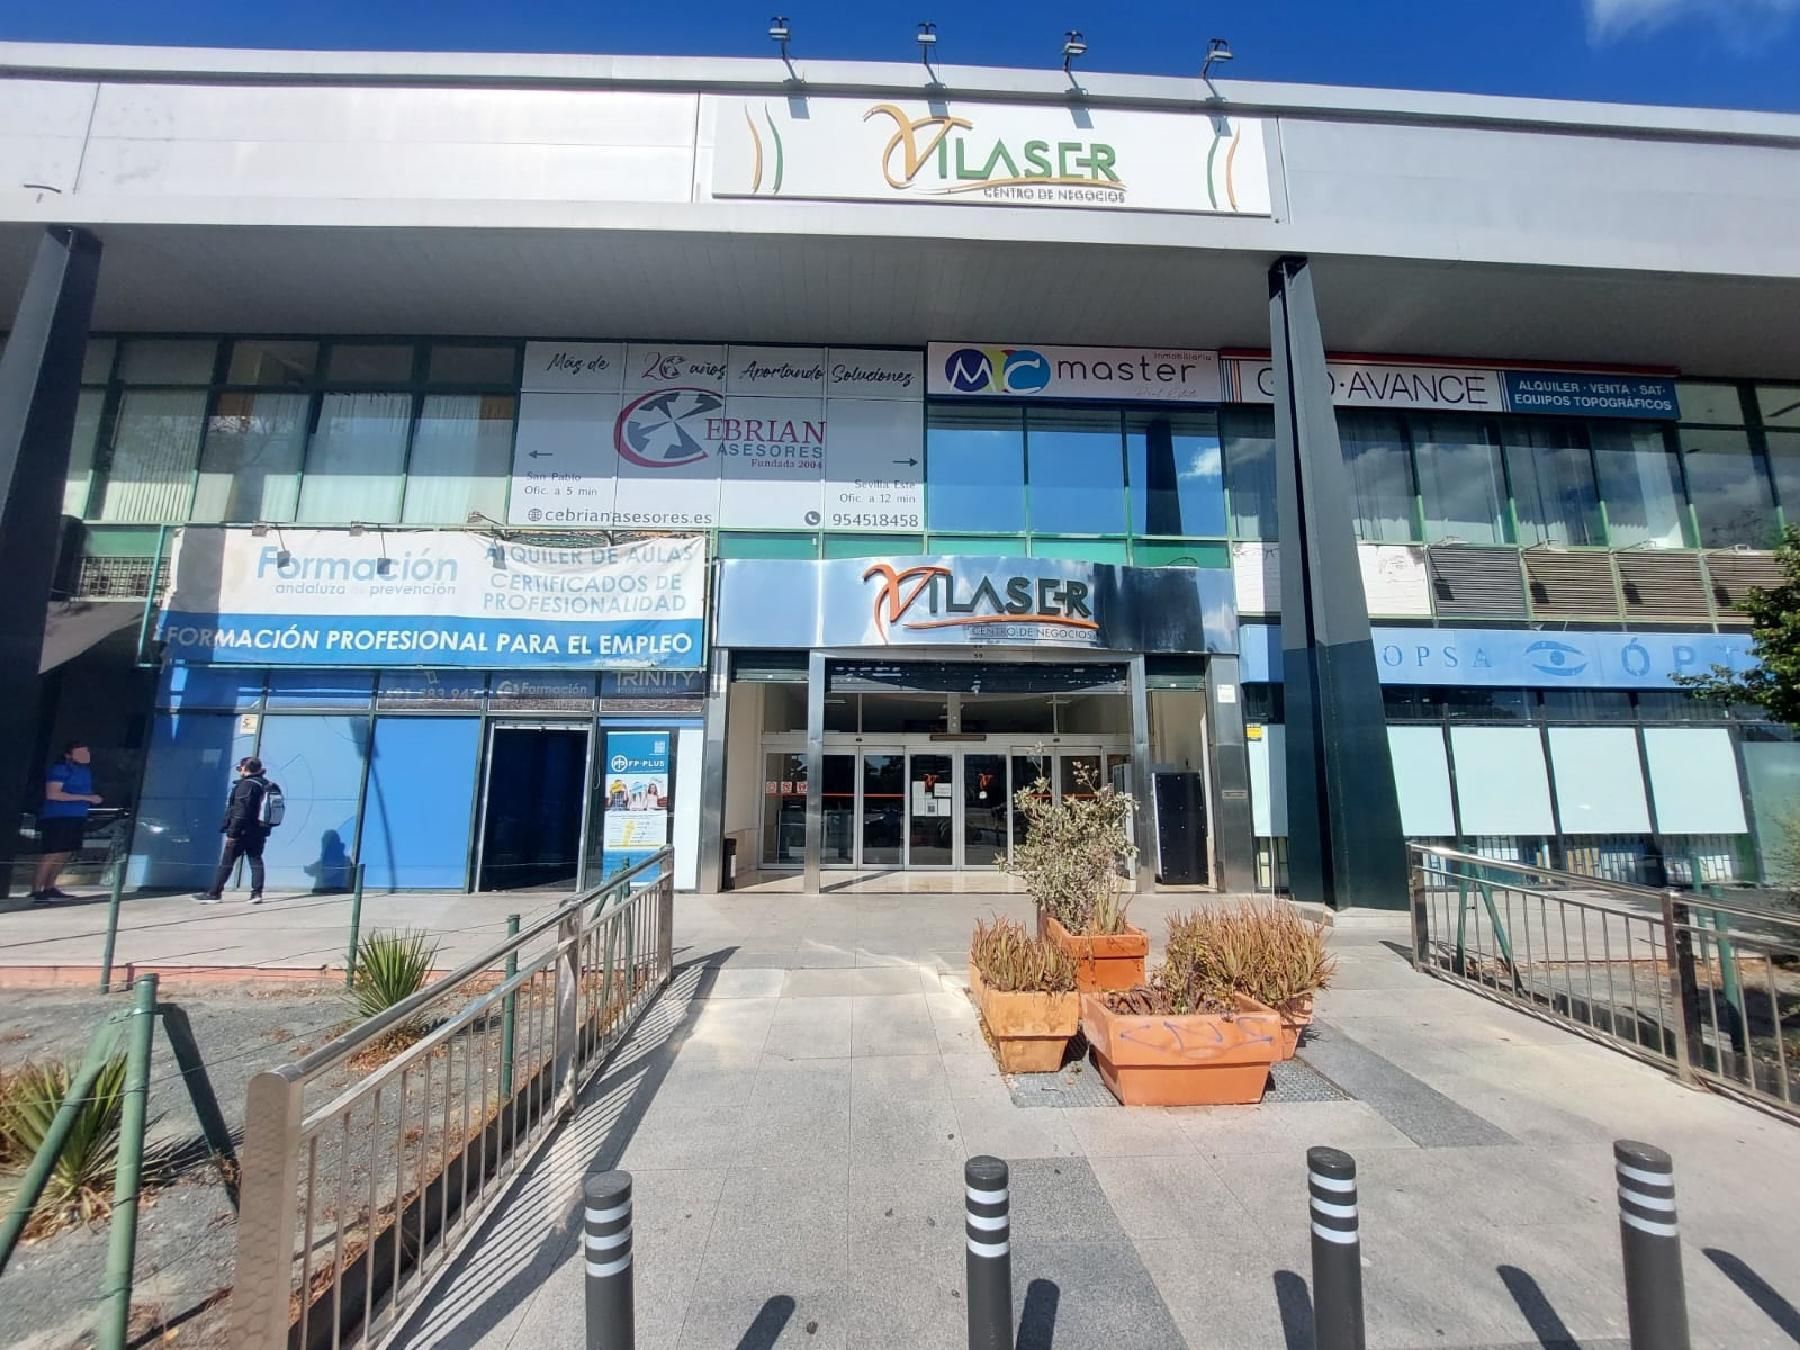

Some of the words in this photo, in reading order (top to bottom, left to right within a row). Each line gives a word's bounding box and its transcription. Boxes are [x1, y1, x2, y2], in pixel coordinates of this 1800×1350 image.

[864, 104, 1121, 188] VILASER
[983, 187, 1034, 200] CENTRO
[1037, 188, 1054, 201] DE
[1058, 189, 1126, 204] NEGOCIOS
[545, 352, 585, 375] Más
[586, 354, 611, 372] de
[690, 360, 727, 381] años
[738, 360, 825, 382] Aportando
[832, 364, 916, 388] Soluciones
[1057, 356, 1196, 384] master
[1518, 379, 1580, 394] ALQUILER
[1589, 383, 1630, 395] VENTA
[1513, 393, 1572, 407] EQUIPOS
[716, 442, 824, 459] ASESORES
[751, 458, 795, 469] Fundada
[527, 471, 547, 481] San
[551, 472, 582, 481] Pablo
[855, 479, 889, 489] Sevilla
[893, 479, 916, 489] Este
[524, 485, 548, 496] Ofic.
[578, 487, 598, 497] min
[839, 493, 862, 504] Ofic.
[880, 493, 892, 504] 12
[897, 494, 916, 504] min
[545, 507, 712, 524] cebrianasesores.es
[832, 512, 919, 528] 954518458
[257, 545, 459, 582] Formación
[591, 546, 619, 566] DE
[626, 545, 693, 563] AULAS
[275, 582, 346, 596] andaluza
[369, 582, 456, 597] prevención
[490, 573, 649, 594] CERTIFICADOS
[655, 574, 682, 591] DE
[483, 592, 687, 615] PROFESIONALIDAD
[863, 563, 1093, 632] VILASER
[166, 624, 319, 651] FORMACIÓN
[326, 629, 488, 652] PROFESIONAL
[496, 632, 560, 655] PARA
[568, 634, 592, 655] EL
[599, 632, 693, 656] EMPLEO
[970, 626, 1016, 638] CENTRO
[1018, 627, 1033, 638] DE
[1037, 628, 1096, 641] NEGOCIOS
[614, 671, 696, 687] TRINITY
